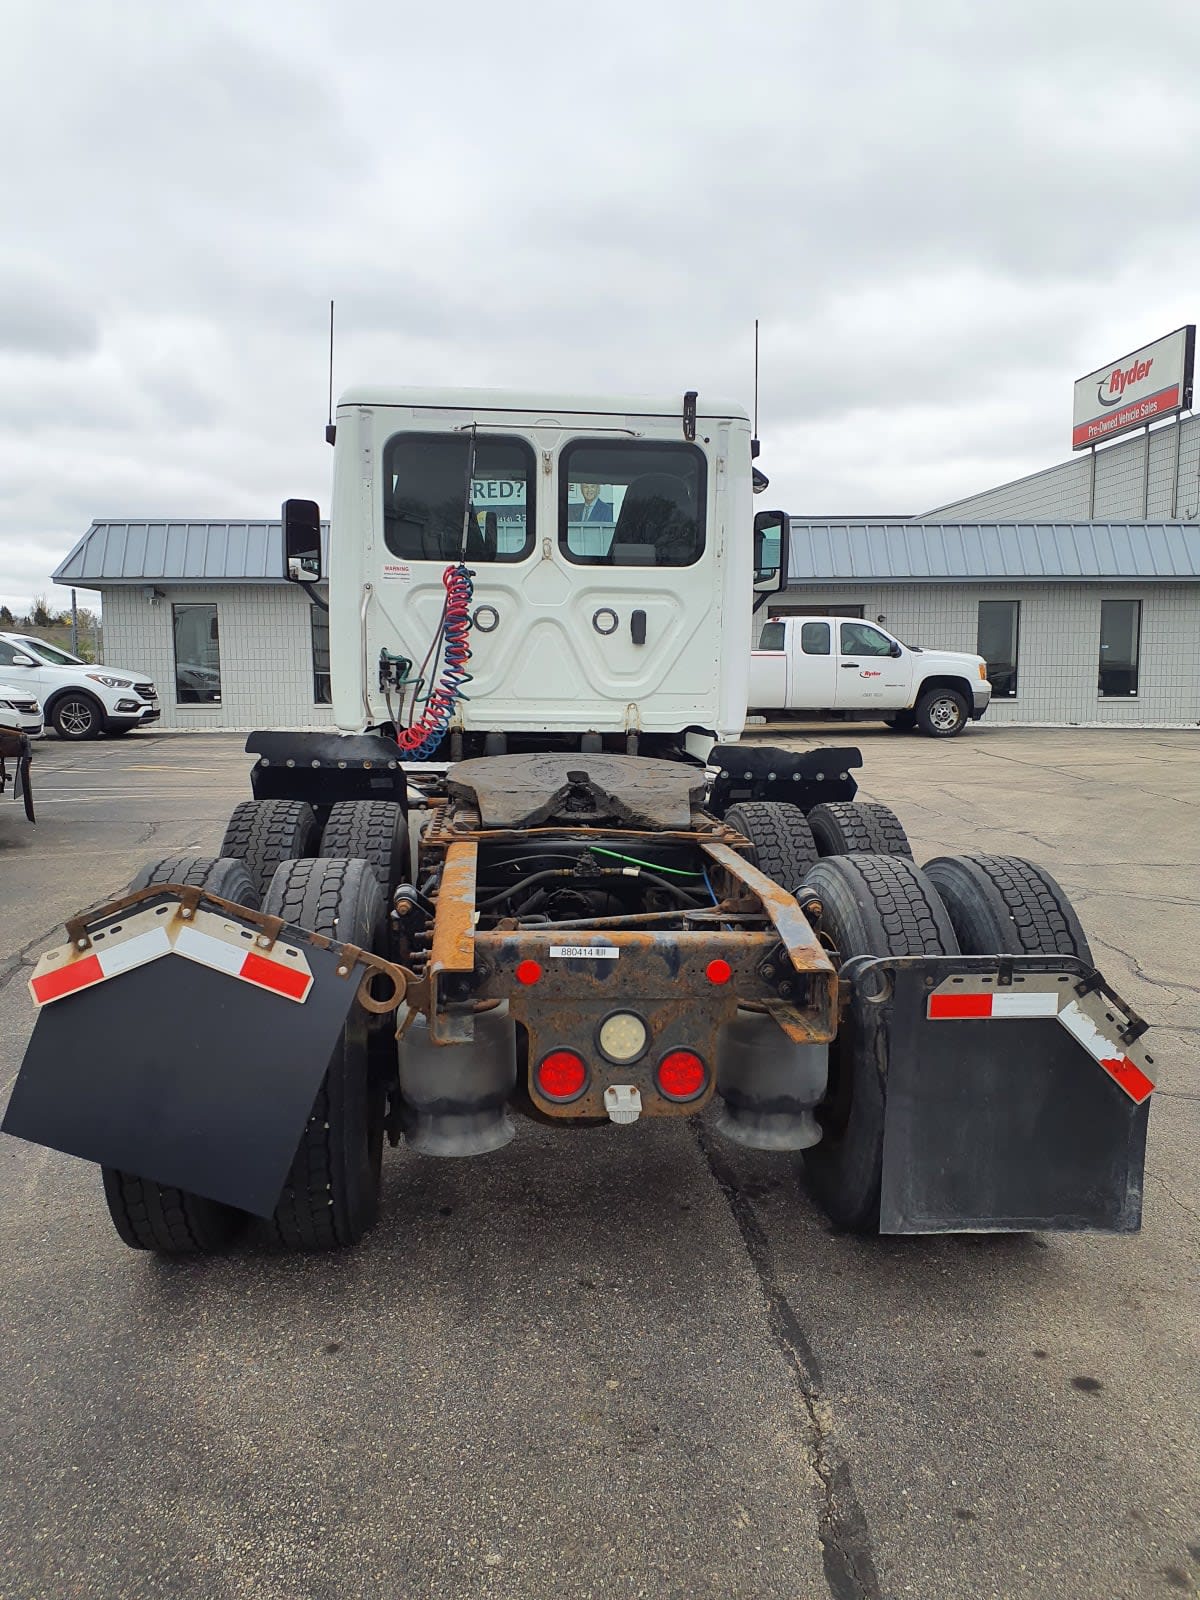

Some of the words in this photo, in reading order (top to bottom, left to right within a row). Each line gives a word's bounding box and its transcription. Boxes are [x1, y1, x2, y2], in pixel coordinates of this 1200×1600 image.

[1109, 358, 1154, 394] Ryder
[1088, 415, 1118, 437] Pre-Owned
[1118, 408, 1140, 425] Vehicle
[1140, 401, 1158, 416] Sales
[864, 670, 881, 678] Ryder
[561, 947, 593, 956] 880414
